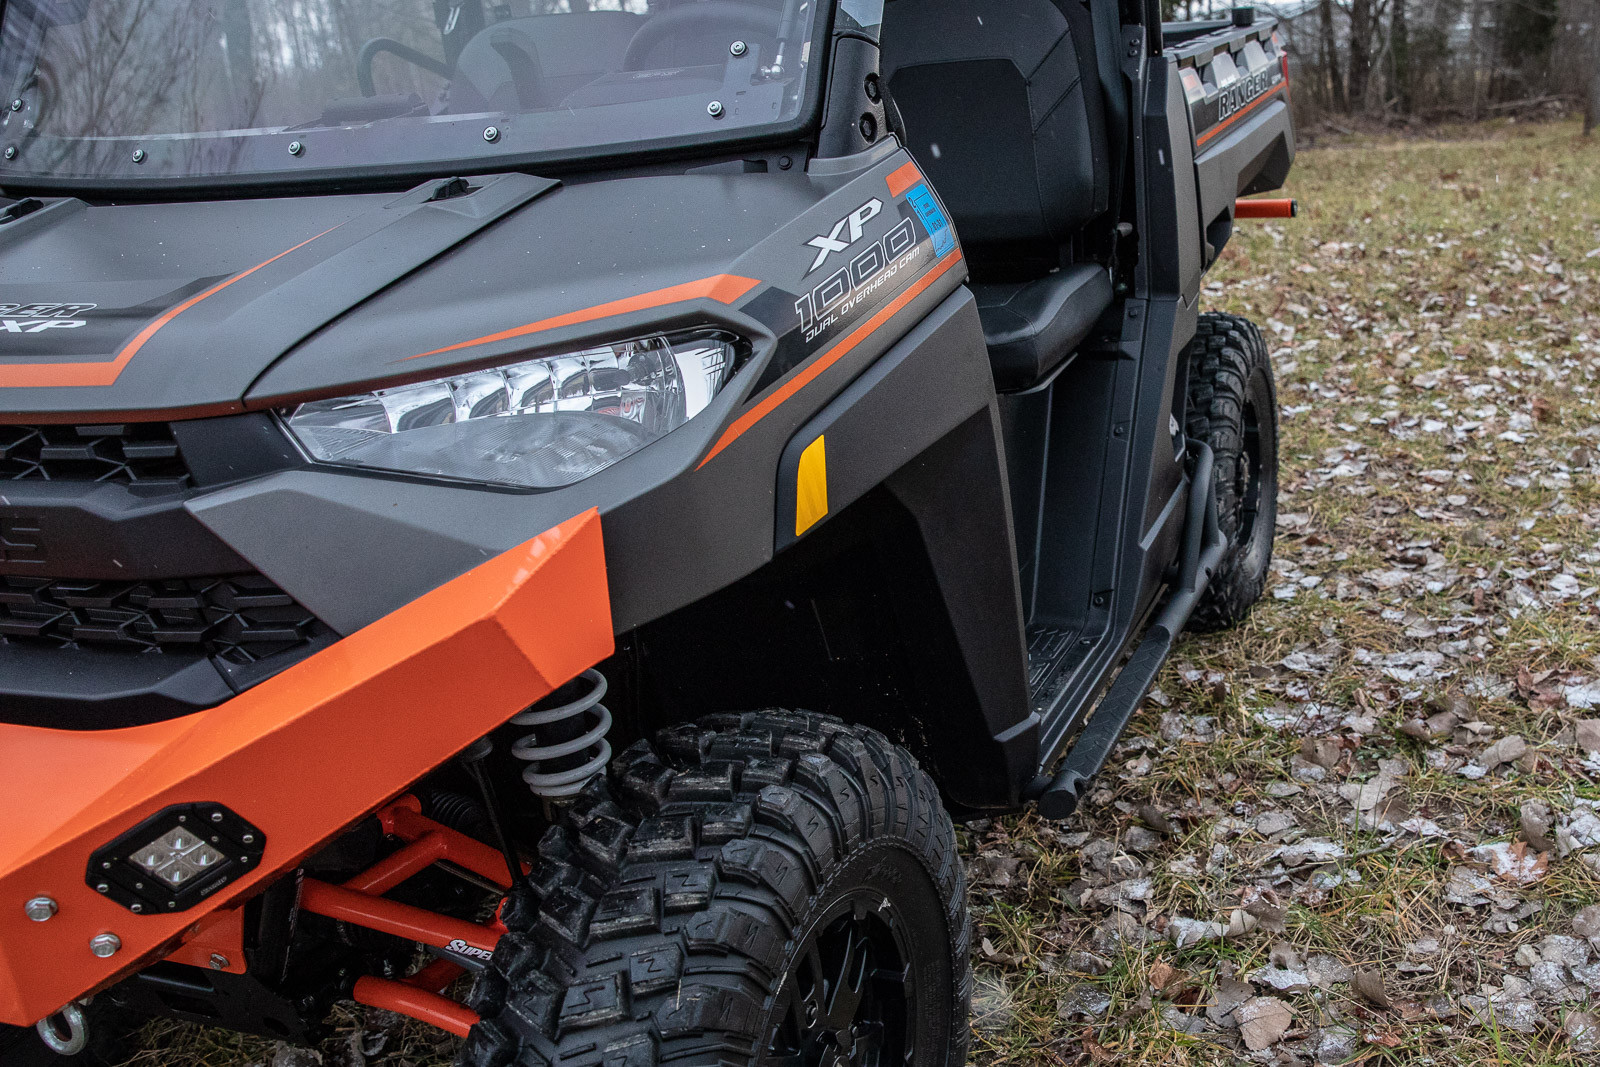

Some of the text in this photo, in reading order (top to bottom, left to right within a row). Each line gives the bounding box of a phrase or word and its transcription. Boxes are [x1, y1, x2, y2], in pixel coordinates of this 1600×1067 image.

[1218, 69, 1269, 121] RANGER
[795, 217, 917, 334] 1000
[803, 197, 883, 280] XP
[0, 319, 87, 333] XP
[805, 246, 920, 343] DUAL OVERHEAD CAM
